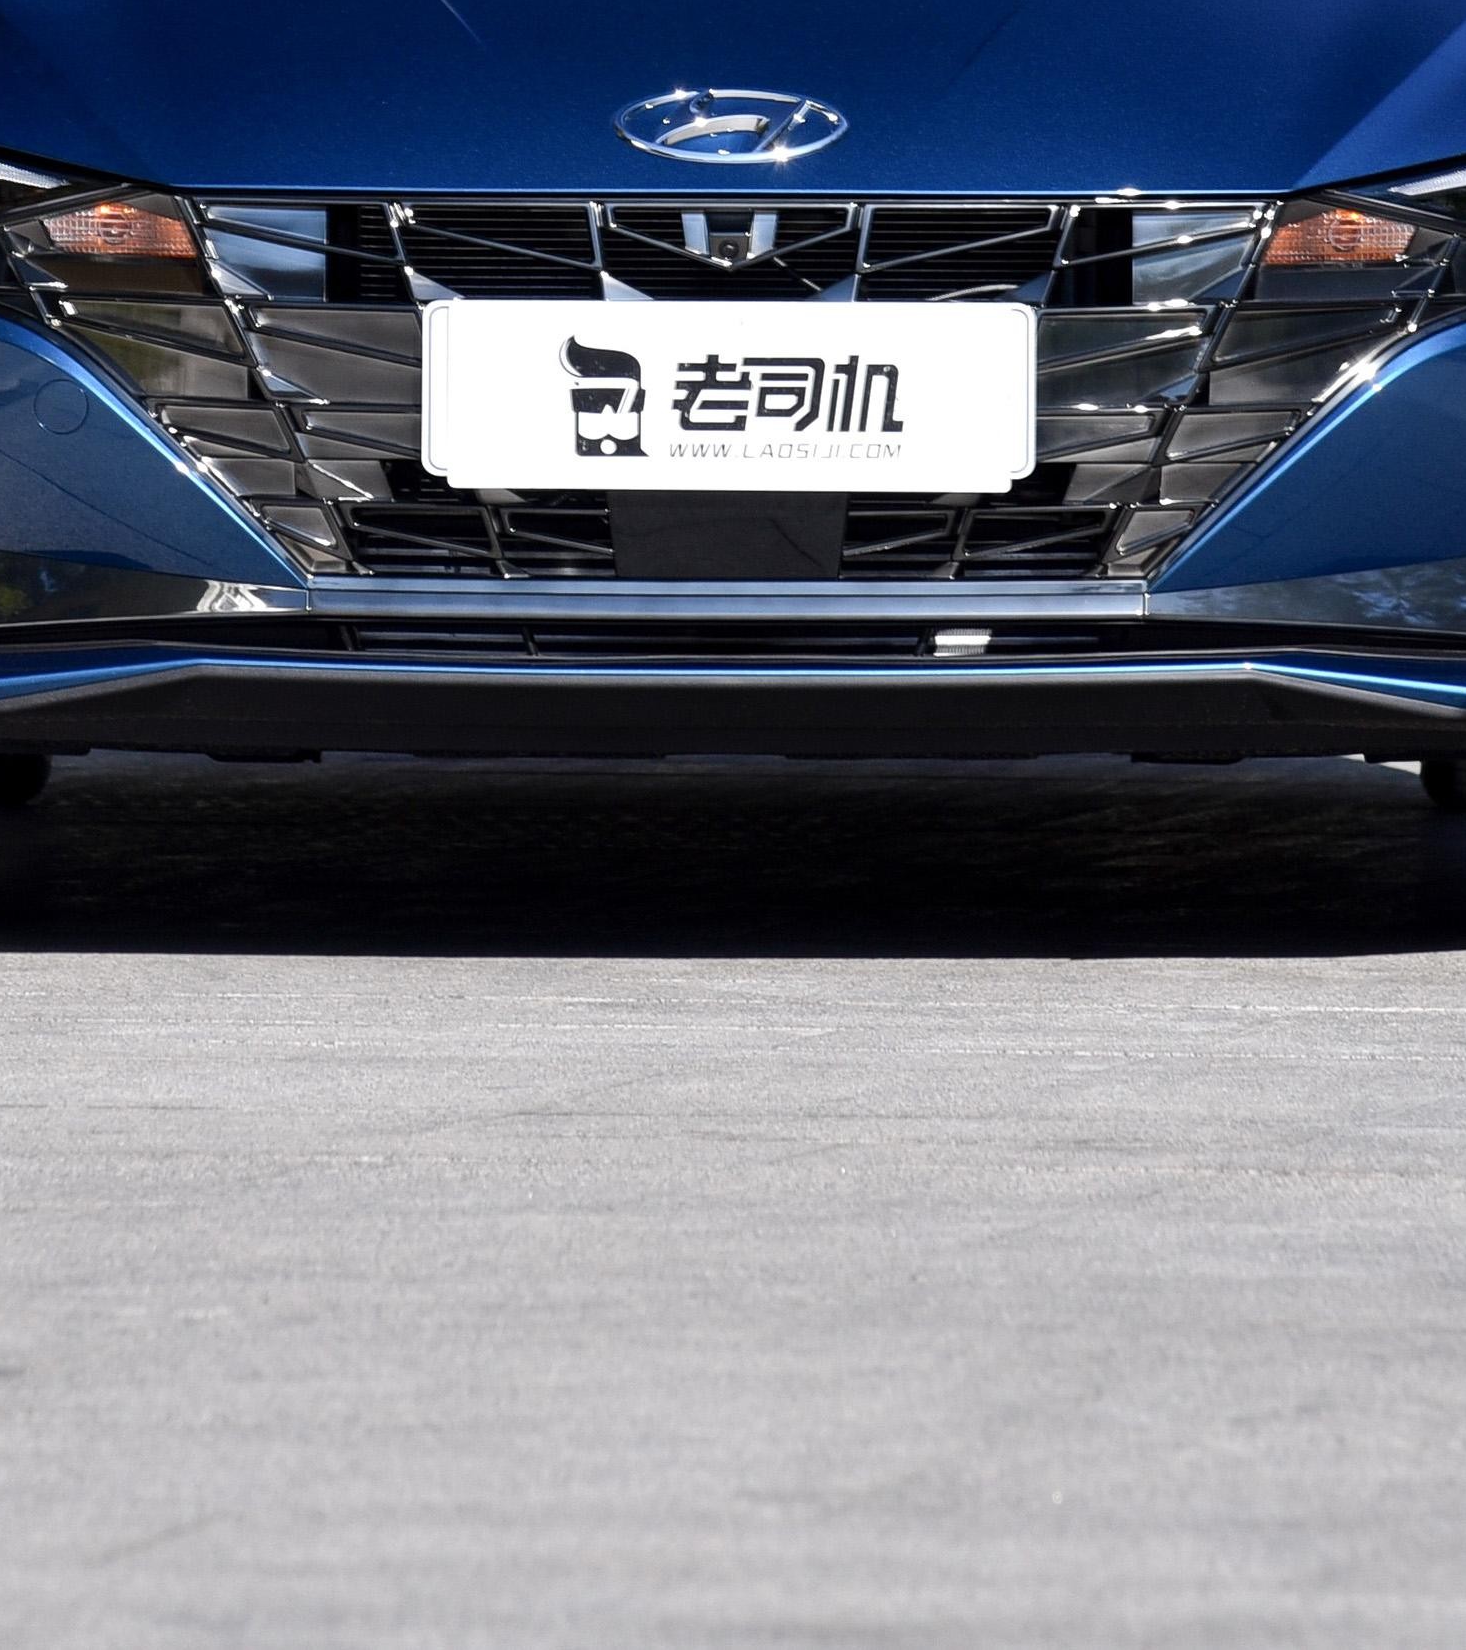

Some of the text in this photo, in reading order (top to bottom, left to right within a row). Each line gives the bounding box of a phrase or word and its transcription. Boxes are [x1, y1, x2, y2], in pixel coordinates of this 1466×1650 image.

[671, 354, 904, 433] 老司机
[668, 443, 903, 459] WWW.LAOSIJI.COM
